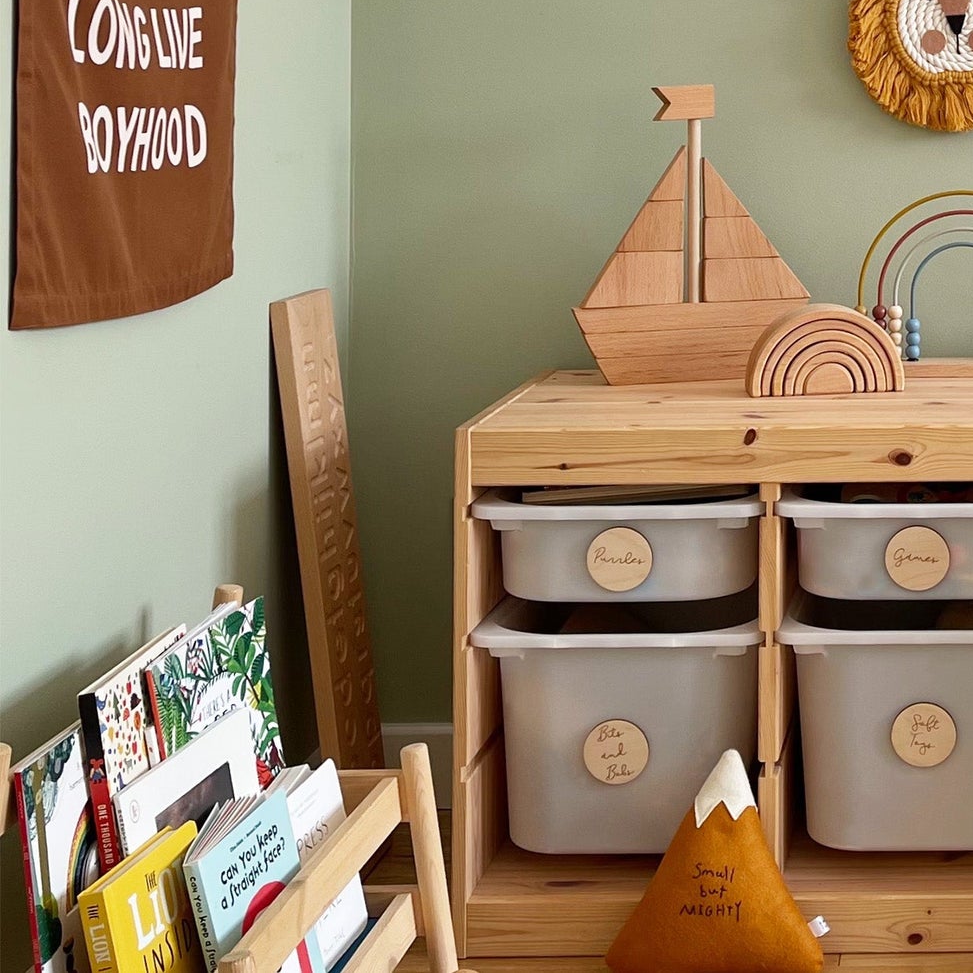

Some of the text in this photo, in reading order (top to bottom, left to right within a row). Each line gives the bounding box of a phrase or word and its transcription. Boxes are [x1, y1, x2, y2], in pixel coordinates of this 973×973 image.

[150, 5, 203, 70] LIVE
[78, 100, 208, 174] BOYHOOD
[593, 547, 645, 565] Puzzles
[893, 548, 940, 568] Games
[597, 724, 624, 742] Bits
[911, 714, 941, 732] Soft
[601, 743, 627, 760] and
[909, 732, 936, 755] Toys
[605, 763, 635, 780] Bobs
[97, 804, 114, 865] ONE THOUSAND
[296, 815, 329, 856] PRESS
[144, 870, 158, 893] THE
[221, 896, 229, 910] a
[264, 836, 285, 873] face?
[692, 862, 736, 883] Small
[700, 884, 727, 899] but
[86, 904, 99, 920] THE
[127, 868, 179, 952] LIO
[679, 900, 742, 922] MIGHTY
[89, 923, 112, 964] LION
[143, 919, 192, 973] INSID
